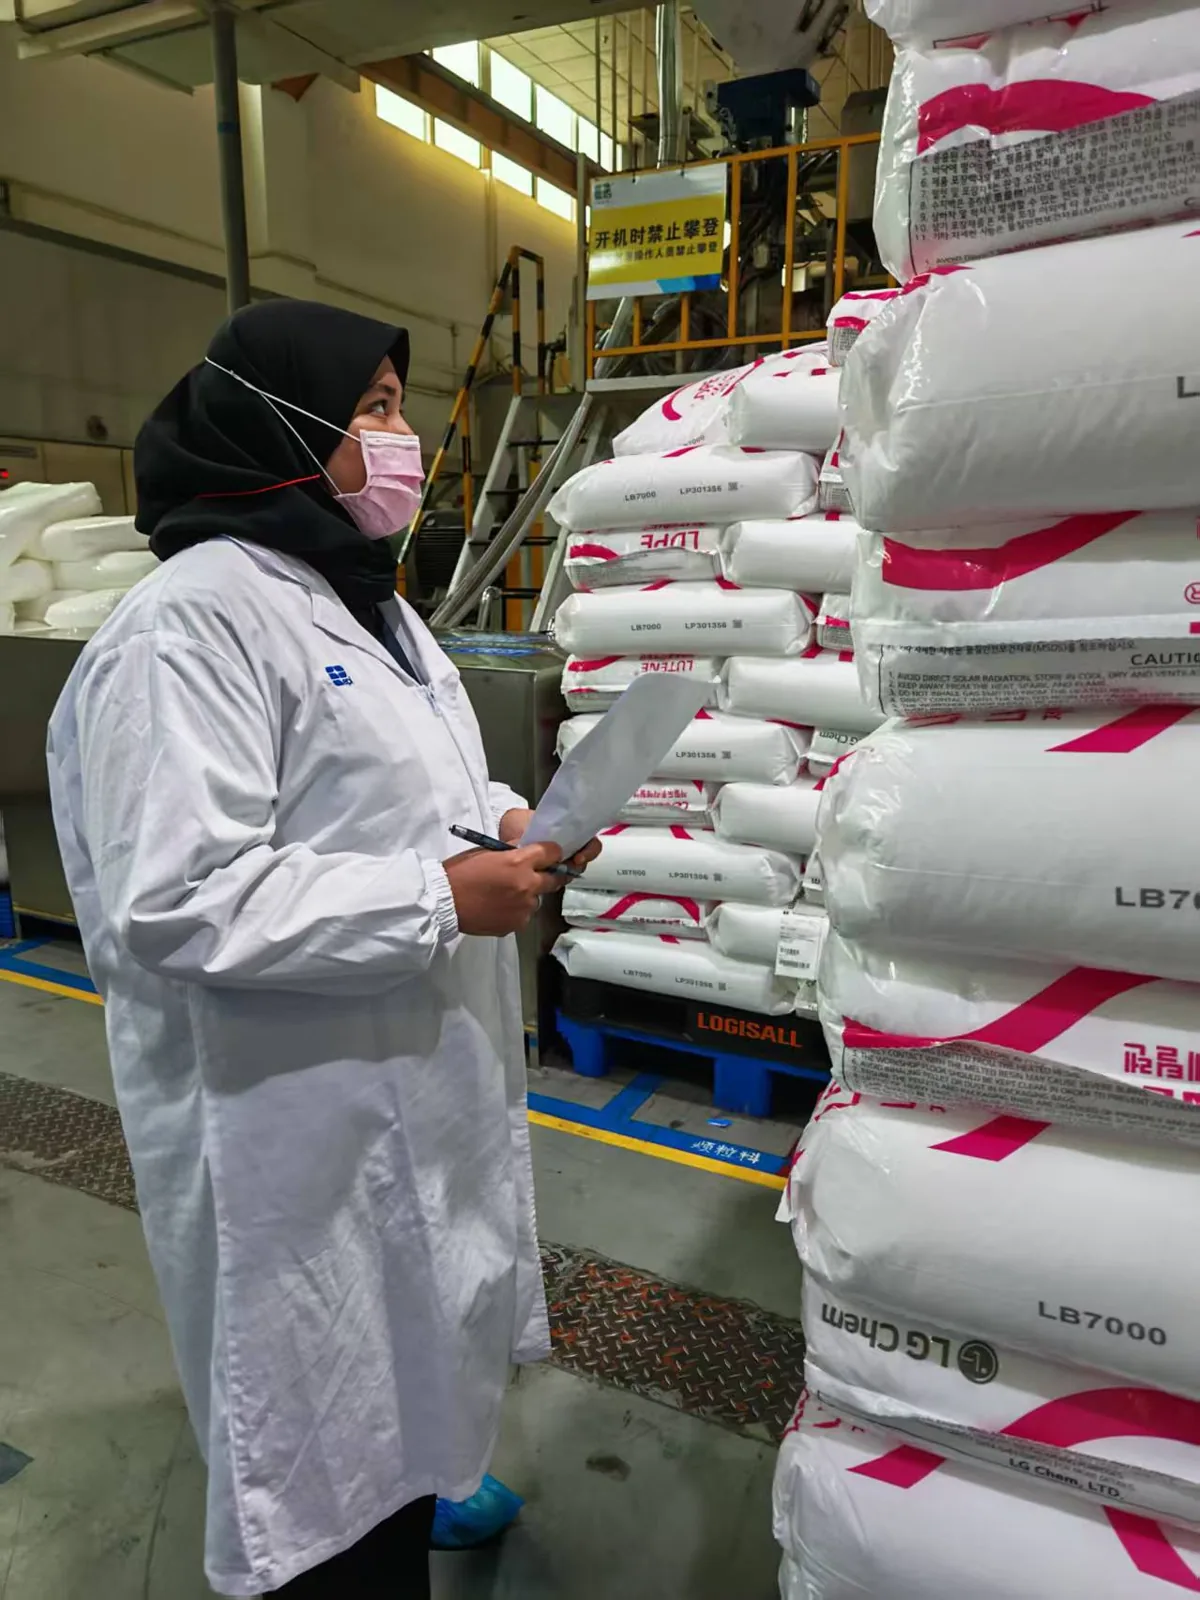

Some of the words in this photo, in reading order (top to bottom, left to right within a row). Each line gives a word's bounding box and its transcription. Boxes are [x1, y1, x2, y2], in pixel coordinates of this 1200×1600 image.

[594, 216, 719, 249] 开机时禁止攀登
[624, 490, 657, 502] LB7000
[630, 622, 662, 632] LB7000
[684, 621, 727, 631] LP301356
[640, 659, 694, 673] LUTENE
[818, 730, 849, 744] Chem
[675, 751, 717, 759] LP301356
[697, 1012, 803, 1048] LOGISALL
[821, 1302, 900, 1353] Chem
[1038, 1301, 1167, 1346] LB7000
[906, 1330, 951, 1368] LG
[1008, 1457, 1031, 1471] LG
